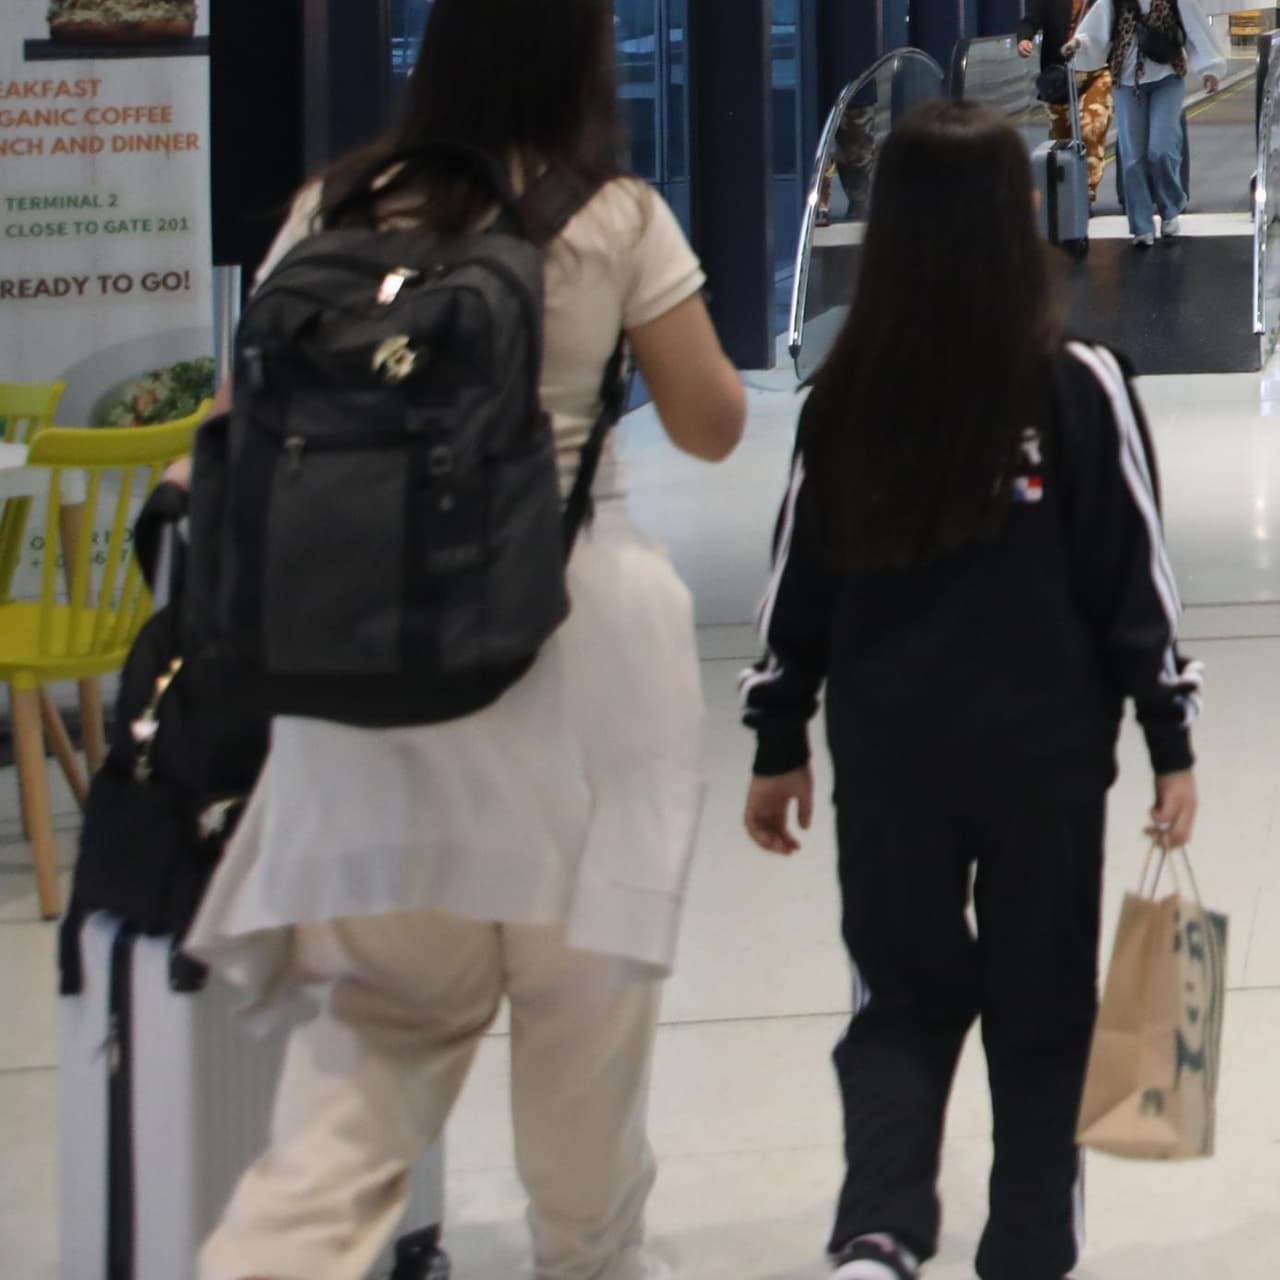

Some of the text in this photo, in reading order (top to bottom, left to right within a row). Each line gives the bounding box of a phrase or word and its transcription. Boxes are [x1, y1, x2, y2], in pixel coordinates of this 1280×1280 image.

[83, 105, 174, 126] COFFEE
[51, 135, 105, 155] AND
[111, 133, 200, 153] DINNER
[5, 193, 119, 212] TERMINAL 2
[5, 216, 189, 239] CLOSE TO GATE 201
[0, 270, 192, 300] READY TO GO!
